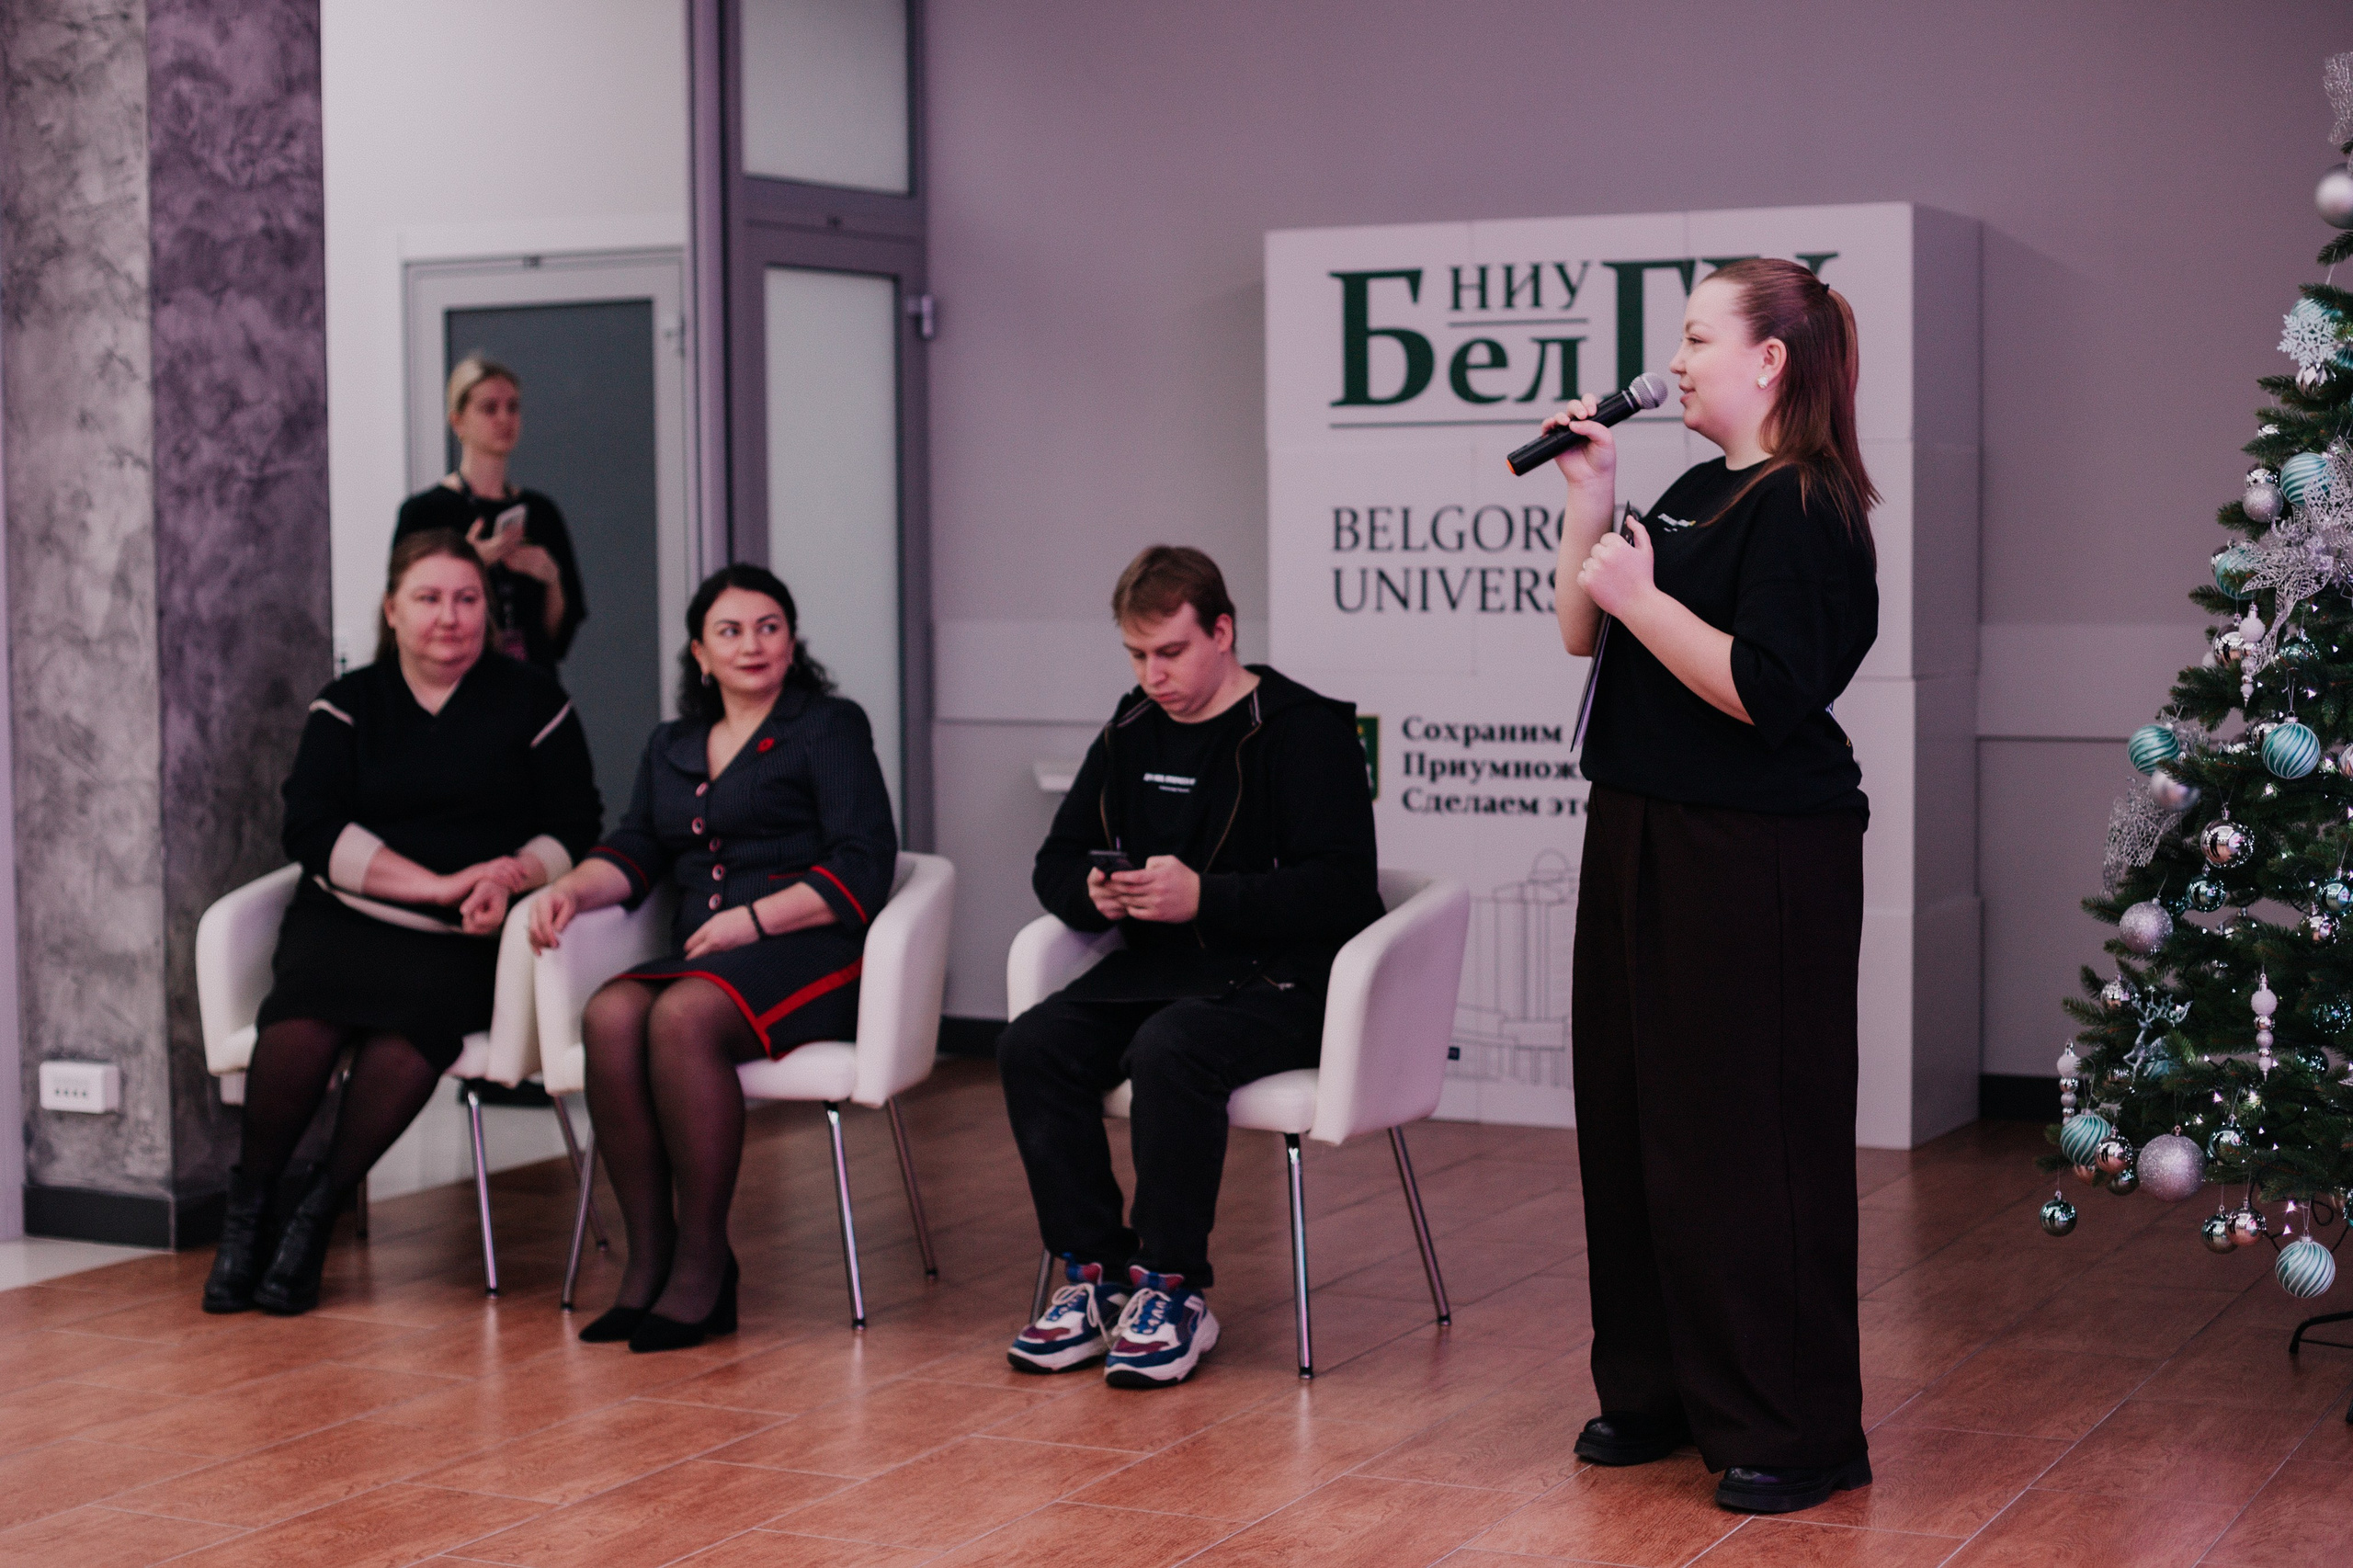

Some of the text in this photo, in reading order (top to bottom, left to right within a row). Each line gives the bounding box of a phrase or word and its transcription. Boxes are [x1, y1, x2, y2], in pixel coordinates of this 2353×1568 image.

[1449, 260, 1589, 311] НИУ
[1329, 252, 1840, 408] БелГ
[1332, 506, 1643, 551] BELGOR
[1402, 716, 1562, 748] Сохраним
[1403, 752, 1586, 784] Приумнож
[1402, 787, 1540, 814] Сделаем
